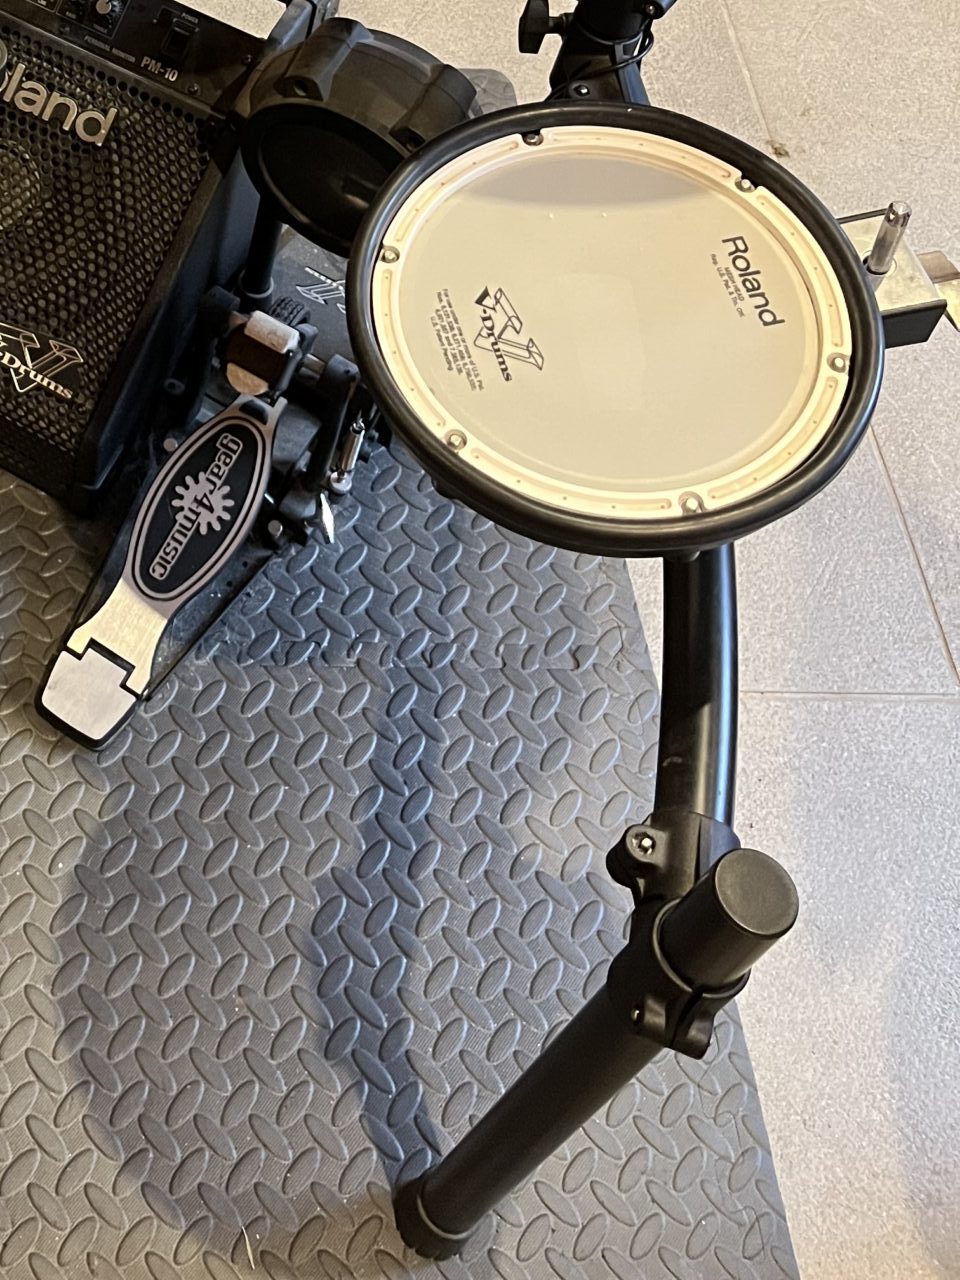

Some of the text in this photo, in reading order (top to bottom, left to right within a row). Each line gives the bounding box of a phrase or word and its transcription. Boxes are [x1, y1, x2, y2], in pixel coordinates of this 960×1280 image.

[140, 56, 179, 82] PM-10
[721, 235, 786, 327] Roland
[474, 285, 513, 382] V-Drums
[149, 433, 243, 580] gear4music
